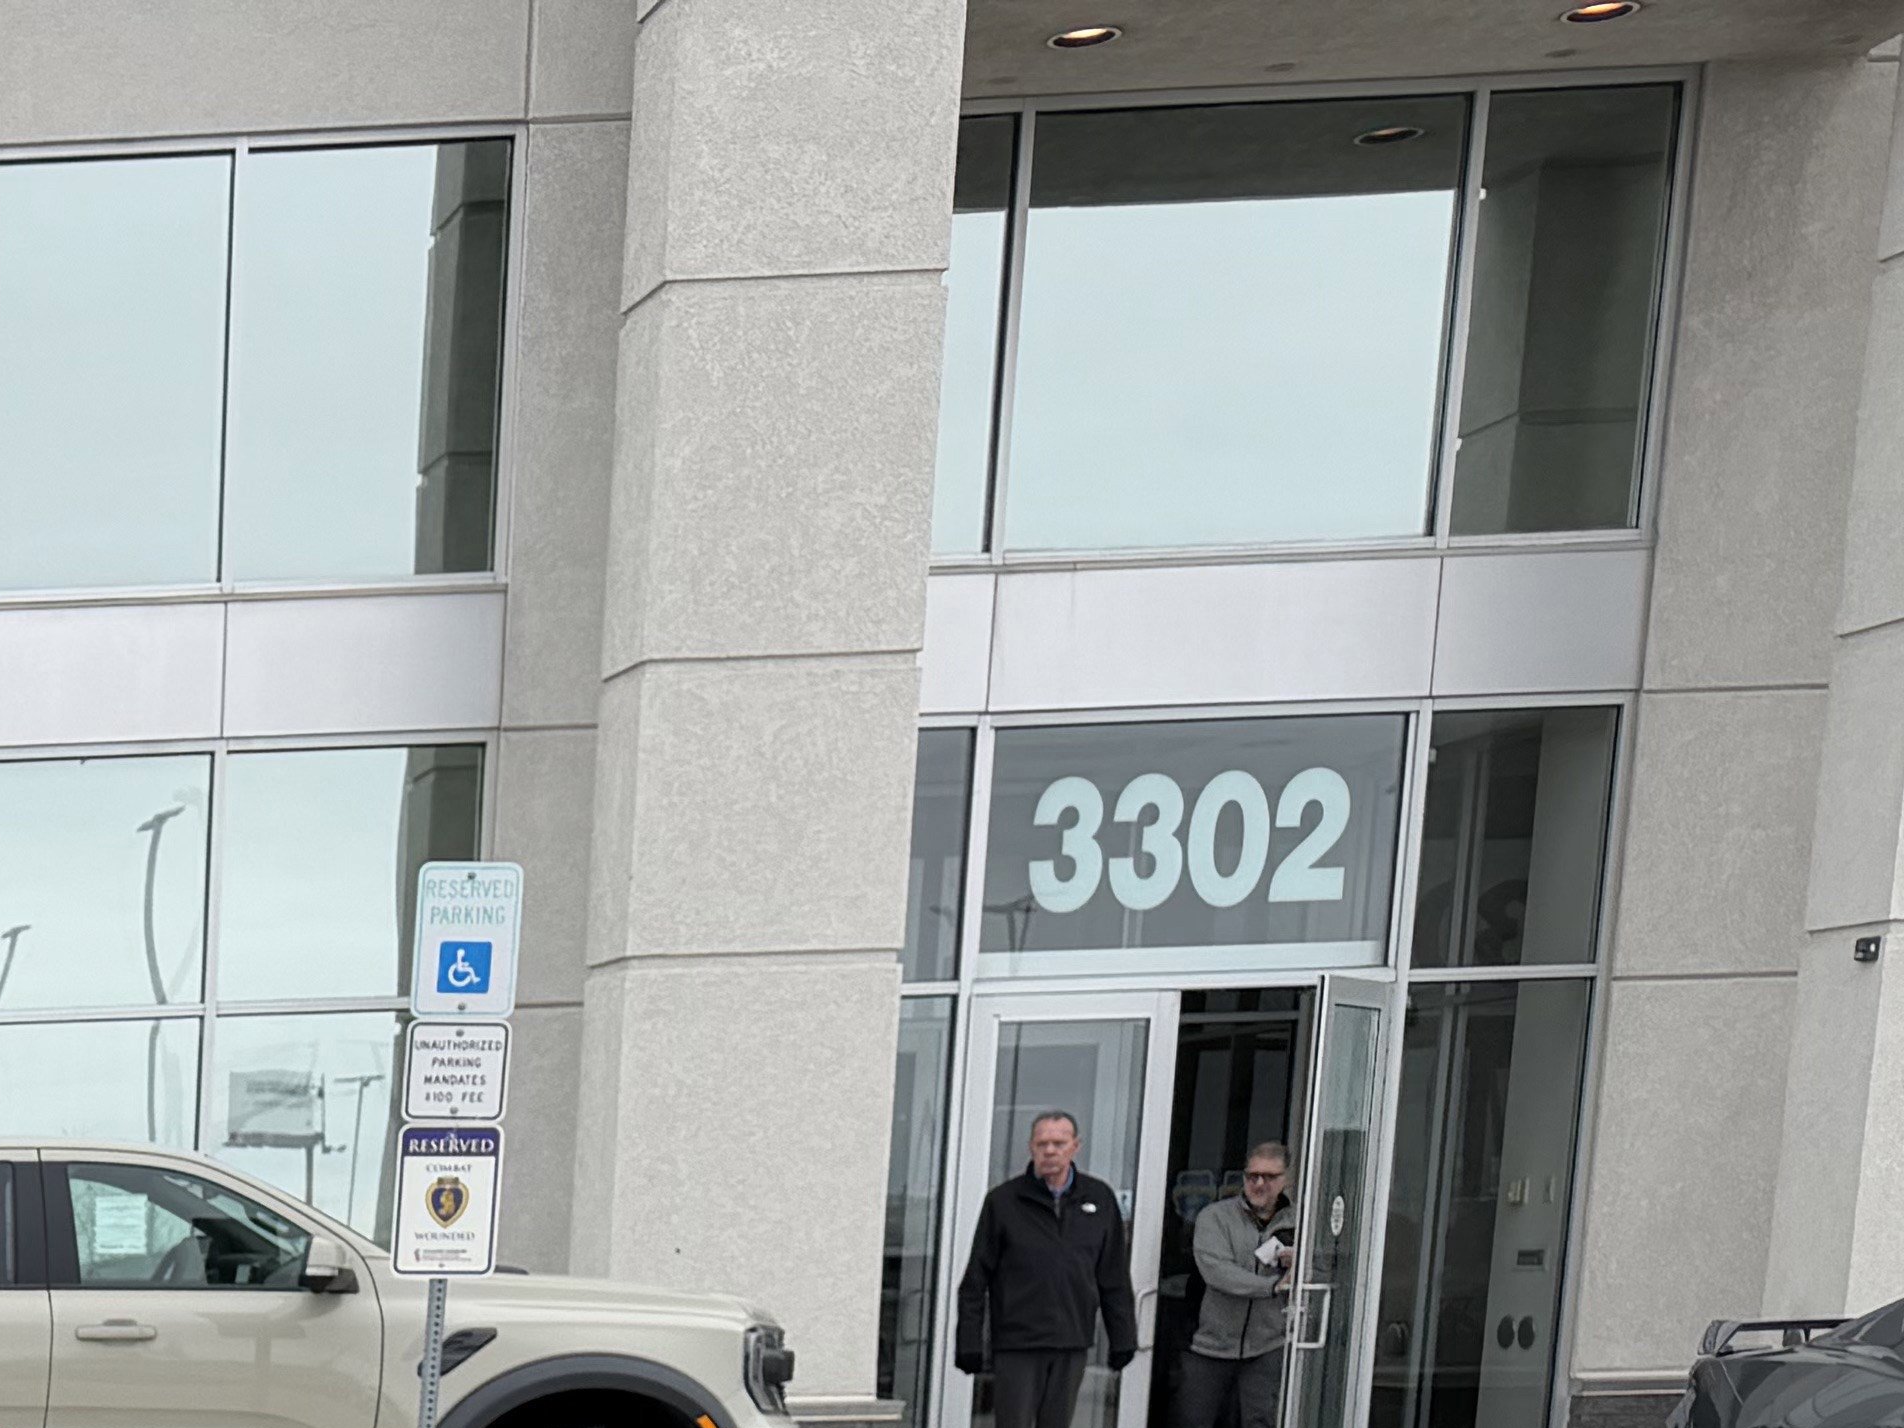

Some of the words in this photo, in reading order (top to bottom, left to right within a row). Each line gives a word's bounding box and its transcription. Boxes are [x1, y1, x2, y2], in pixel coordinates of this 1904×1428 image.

[1028, 766, 1351, 914] 3302
[424, 879, 514, 899] RESERVED
[430, 905, 506, 925] PARKING
[414, 1039, 502, 1051] UNAUTHORIZED
[431, 1056, 481, 1069] PARKING
[423, 1074, 486, 1086] MANDATES
[461, 1092, 485, 1103] FEE
[409, 1137, 495, 1153] RESERVED
